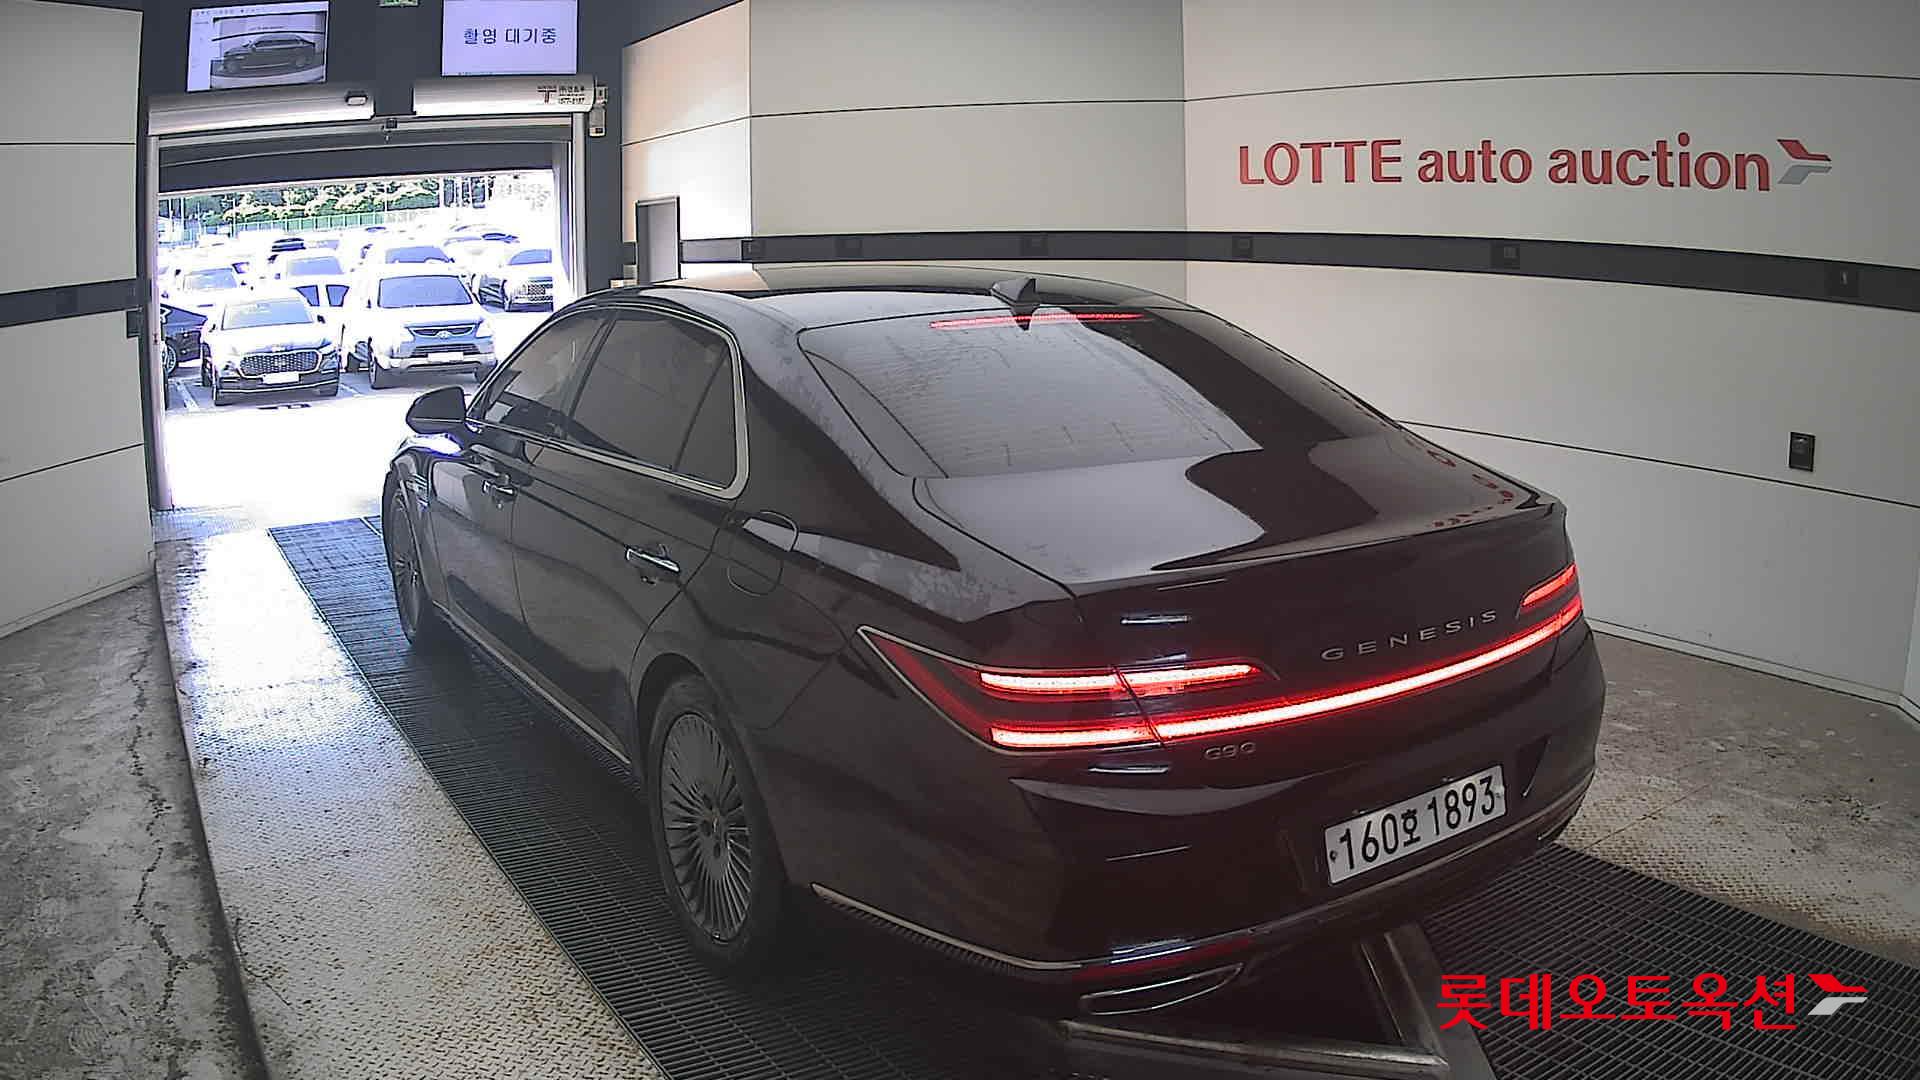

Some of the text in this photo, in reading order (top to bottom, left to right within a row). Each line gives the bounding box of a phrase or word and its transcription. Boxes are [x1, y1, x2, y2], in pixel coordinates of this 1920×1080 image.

[464, 27, 558, 46] 촬영 대기중
[1239, 132, 1771, 192] LOTTE auto auction
[1321, 610, 1497, 661] GENESIS
[1204, 742, 1256, 760] G90
[1339, 775, 1496, 870] 160호 1893
